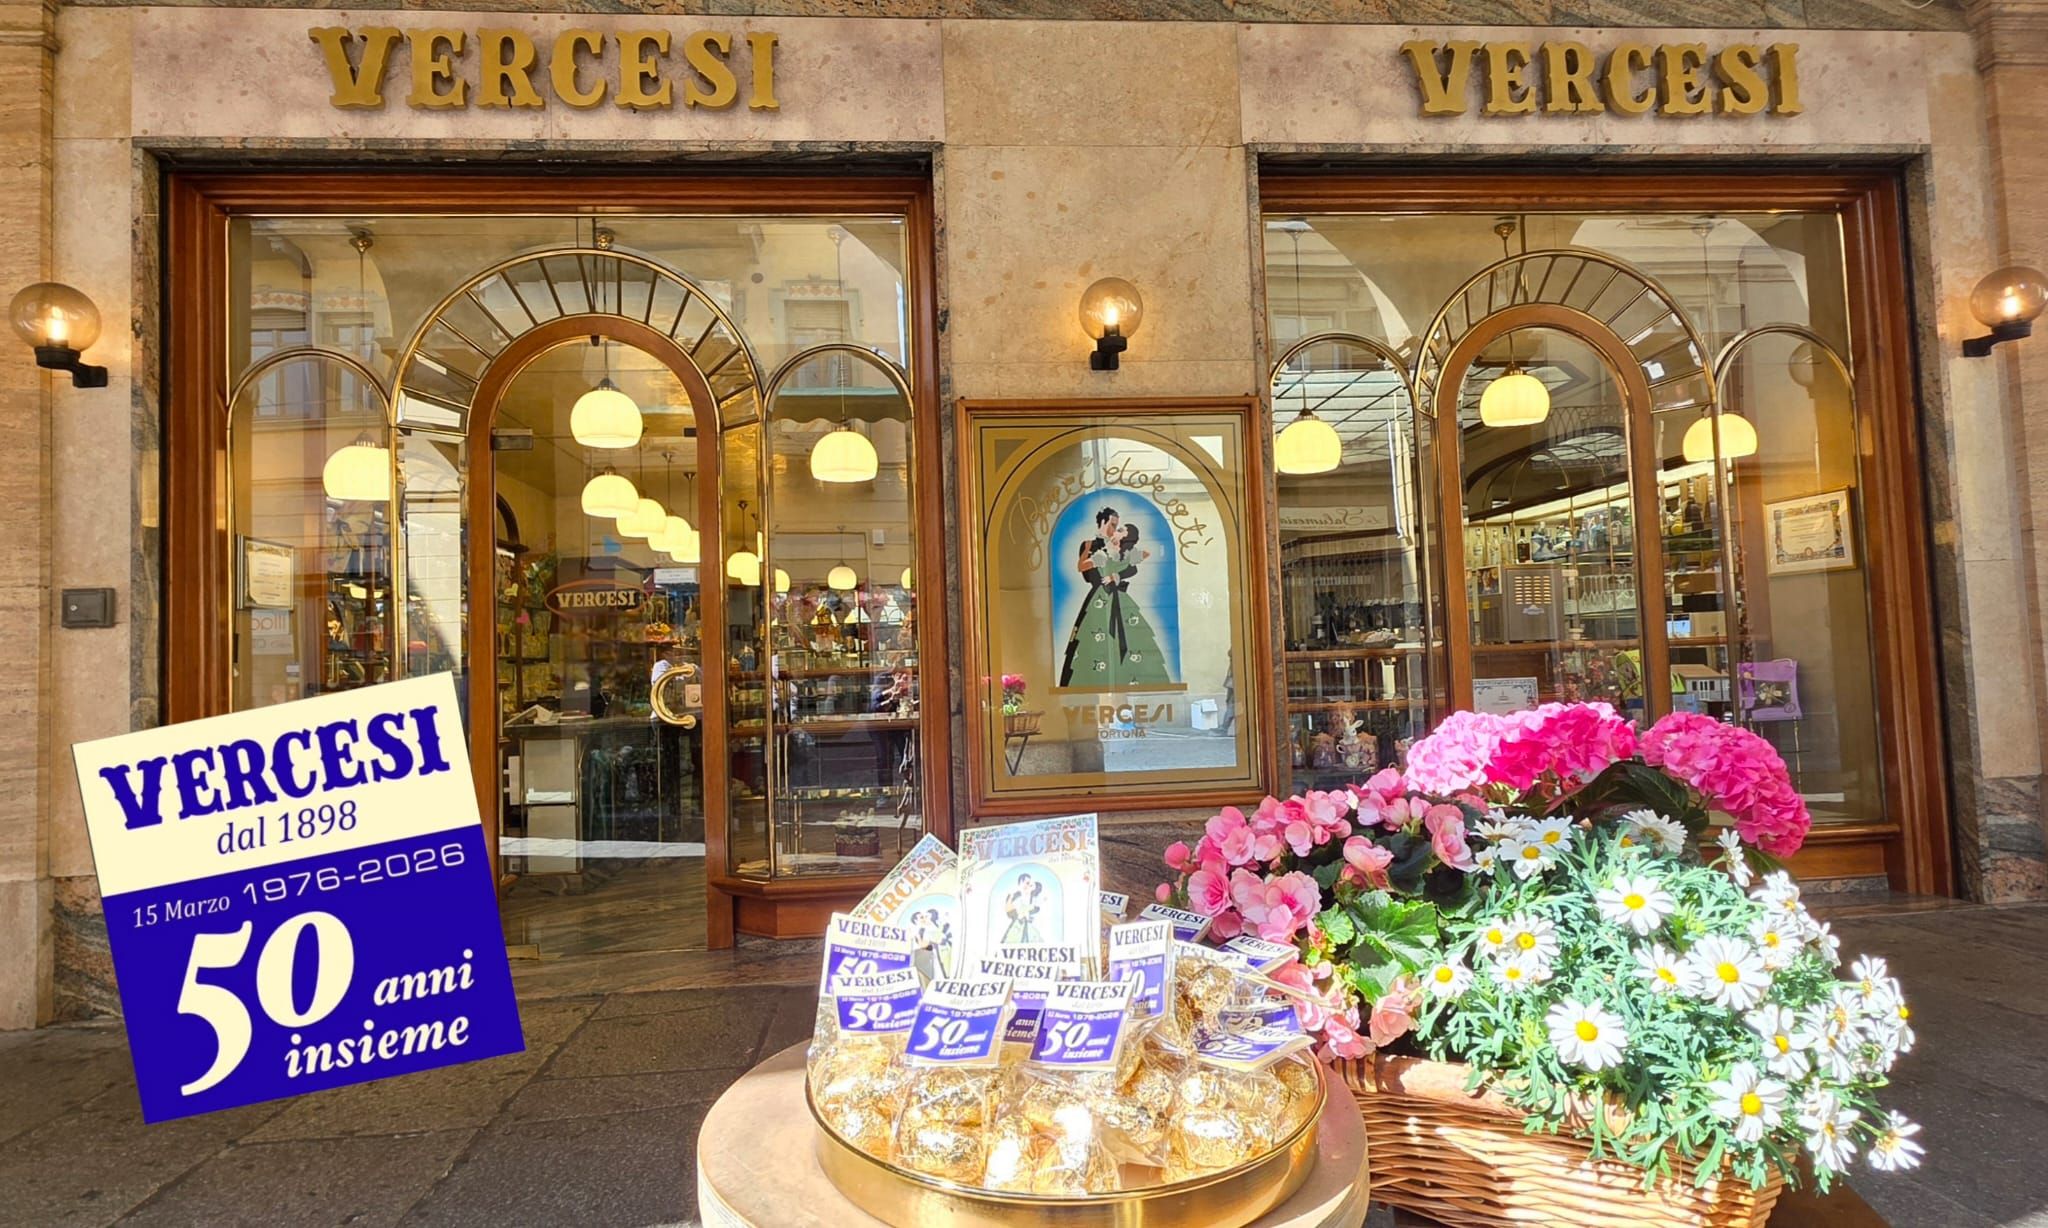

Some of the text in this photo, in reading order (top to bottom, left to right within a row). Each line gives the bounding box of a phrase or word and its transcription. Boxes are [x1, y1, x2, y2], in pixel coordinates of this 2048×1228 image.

[308, 26, 780, 111] VERCESI
[1400, 40, 1802, 117] VERCESI
[556, 590, 636, 608] VERCESI
[1062, 704, 1173, 724] VERCESI
[1095, 729, 1148, 739] ORTONA
[975, 829, 1089, 861] VERCESI
[870, 849, 946, 924] ERCESI
[1151, 905, 1207, 925] VERCESI
[838, 918, 907, 942] VERCESI
[1115, 925, 1164, 946] VERCESI
[1001, 947, 1075, 963] VERCESI
[838, 970, 914, 987] VERCESI
[979, 960, 1052, 979] VERCESI
[934, 981, 1007, 998] VERCESI
[1056, 984, 1127, 1000] VERCESI
[848, 1002, 893, 1029] 50
[914, 1016, 969, 1051] 50
[1040, 1021, 1091, 1057] 50
